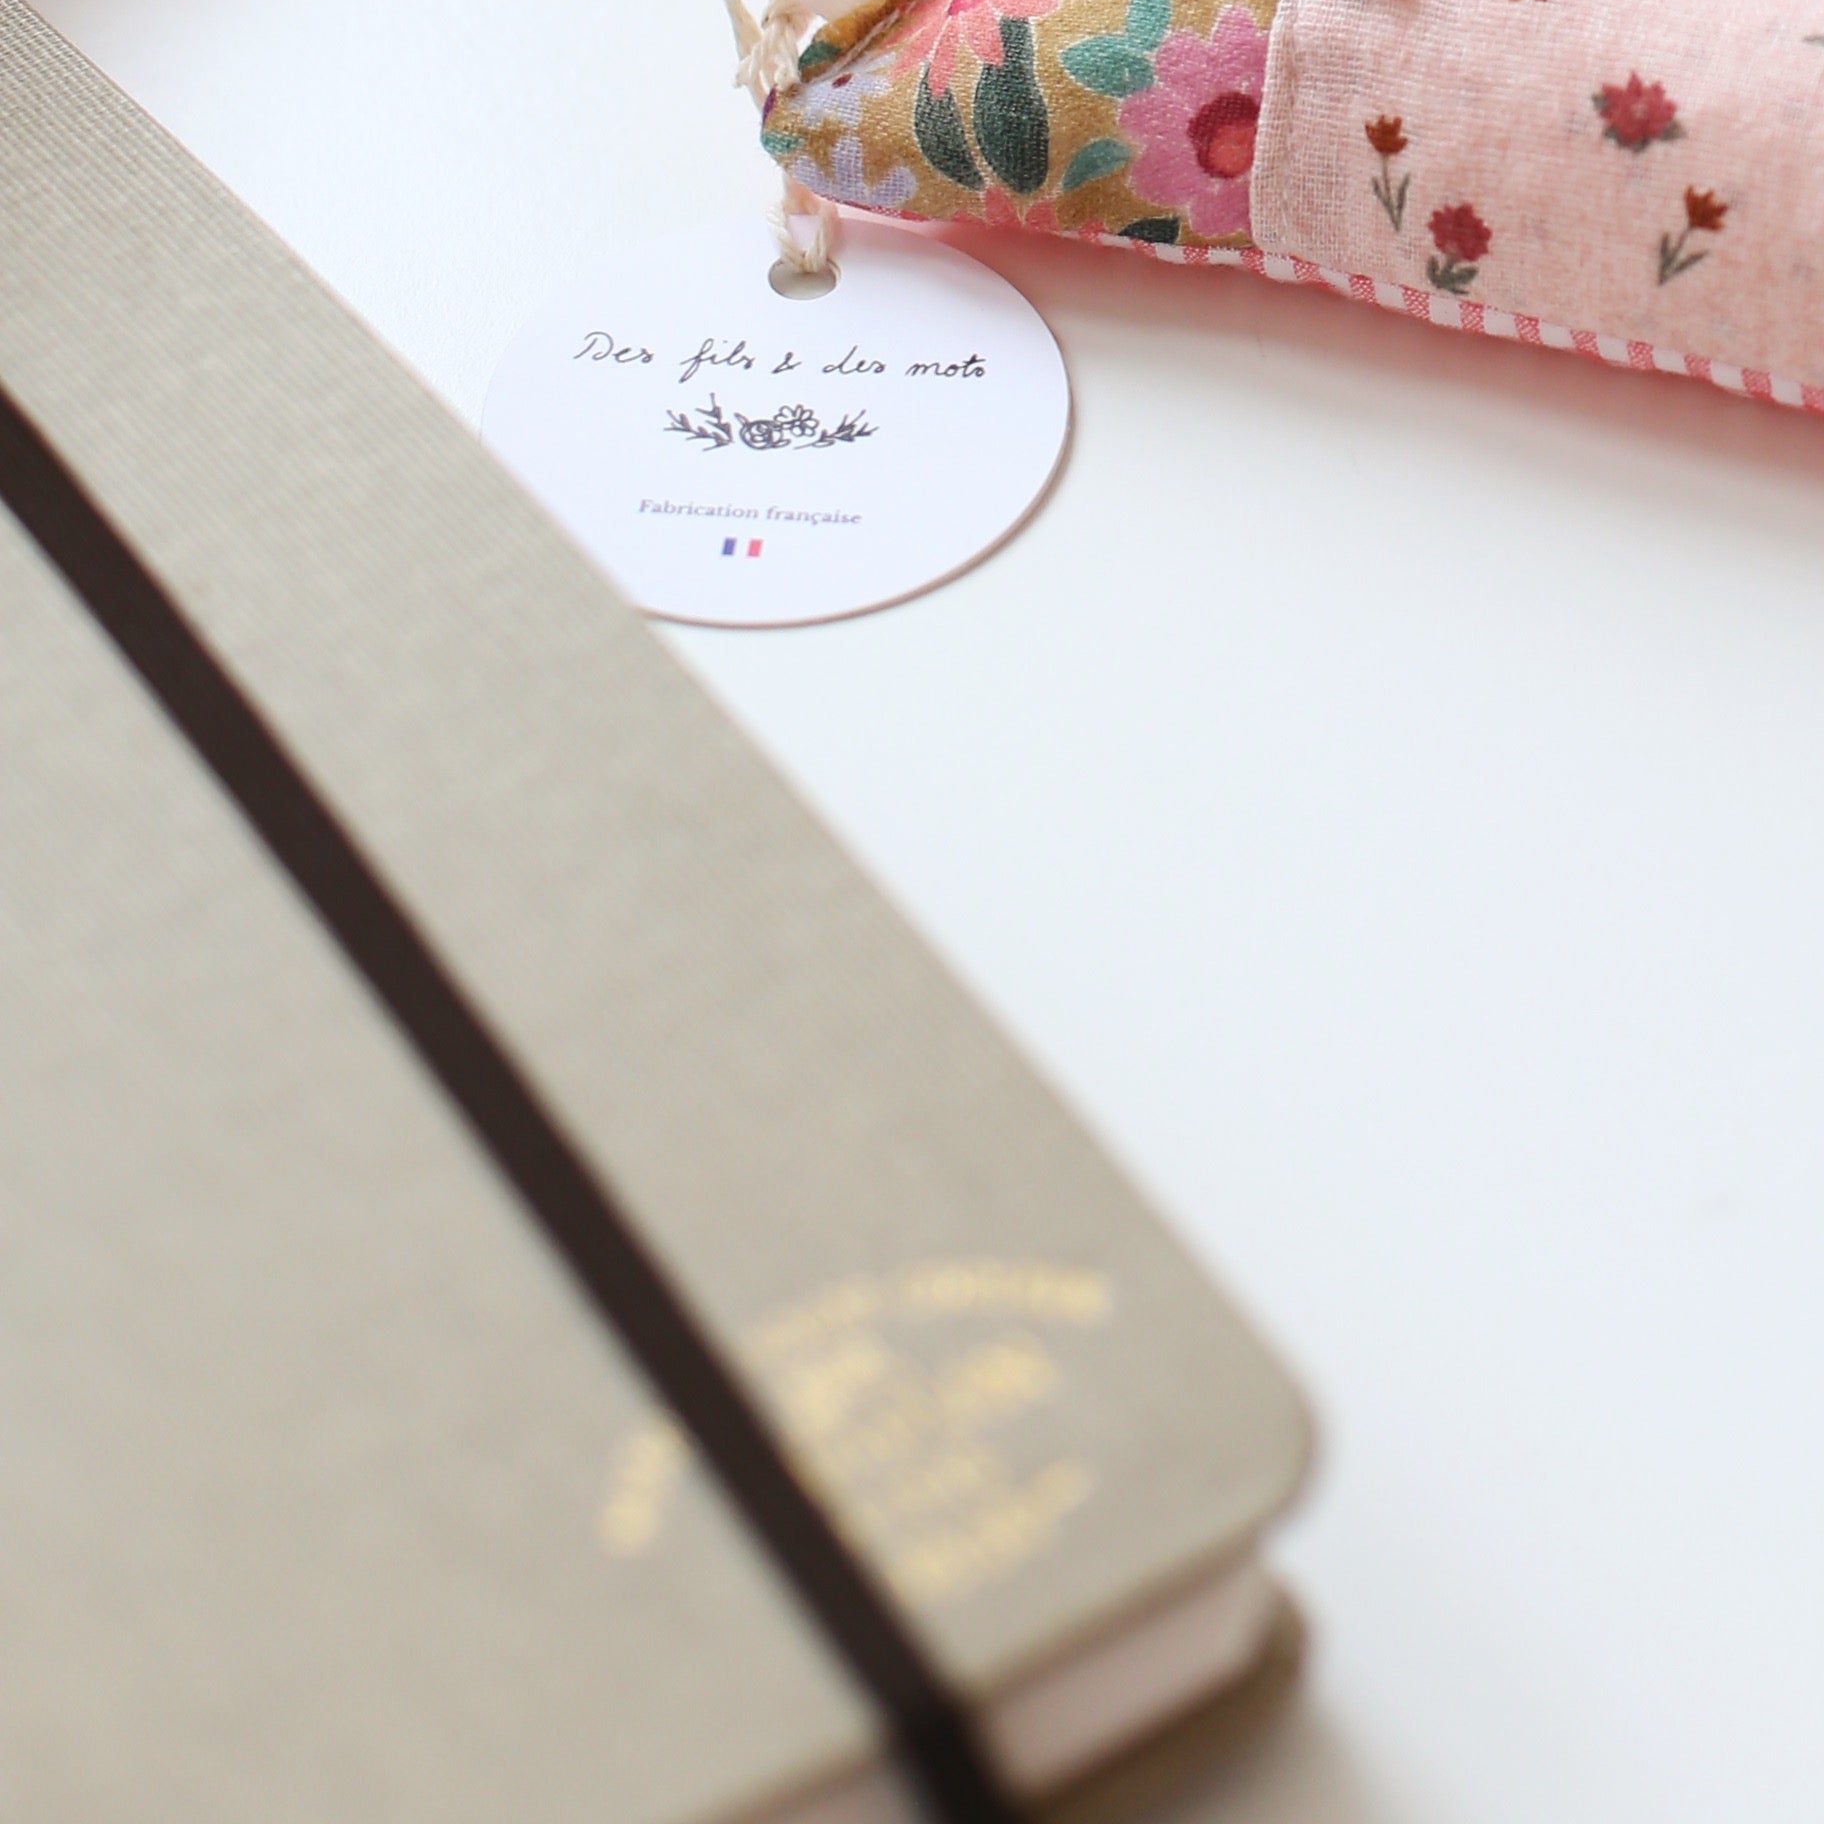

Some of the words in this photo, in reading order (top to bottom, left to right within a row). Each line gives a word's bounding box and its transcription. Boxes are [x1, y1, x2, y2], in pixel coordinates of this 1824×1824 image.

[573, 331, 655, 364] Des
[679, 338, 756, 383] fils
[771, 352, 802, 374] &
[822, 345, 887, 375] des
[904, 354, 987, 379] mots
[638, 499, 759, 520] Fabrication
[766, 505, 862, 526] française
